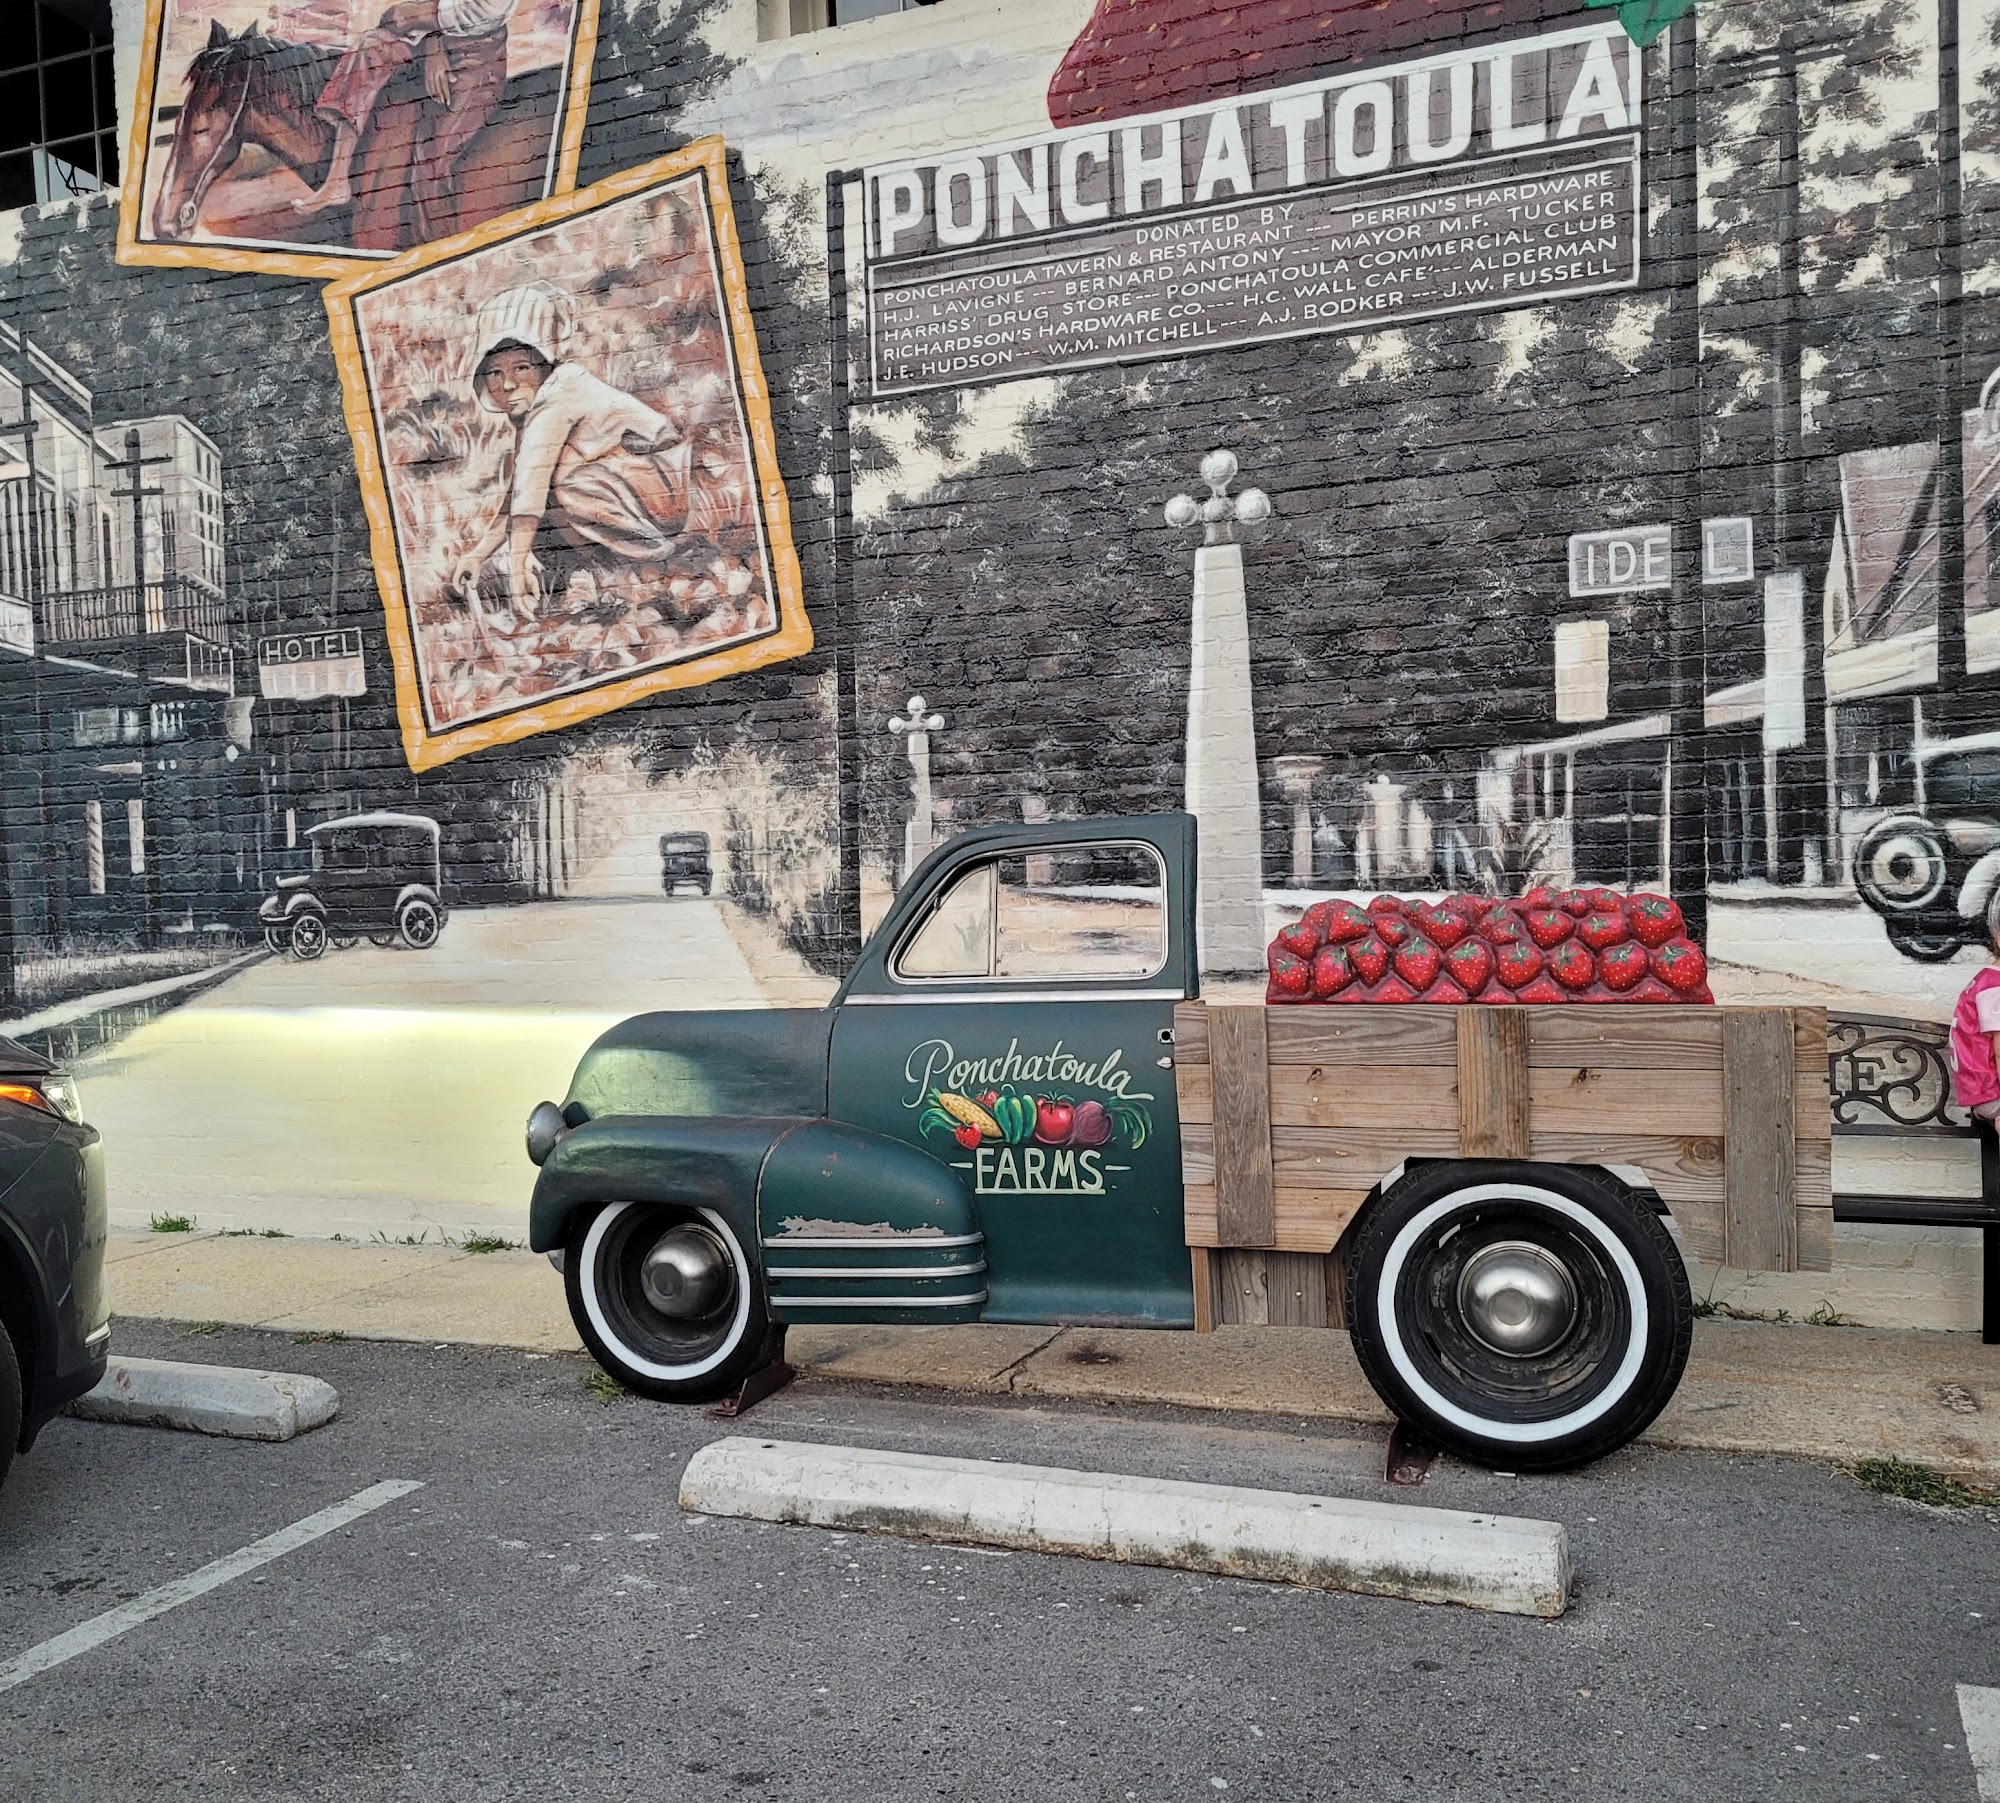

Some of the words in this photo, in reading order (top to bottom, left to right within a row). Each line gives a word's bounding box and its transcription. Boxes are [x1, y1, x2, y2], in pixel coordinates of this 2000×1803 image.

[880, 37, 1630, 256] PONCHATOULA
[884, 270, 1036, 305] PONCHATOULA
[1042, 254, 1121, 280] TAVERN
[1128, 253, 1143, 266] &
[1150, 225, 1294, 262] RESTAURANT
[1352, 197, 1456, 227] PERRIN'S
[1465, 170, 1613, 209] HARDWARE
[884, 309, 919, 324] H.J.
[933, 291, 1025, 317] LAVIGNE
[1065, 267, 1173, 288] BERNARD
[1182, 248, 1285, 277] ANTONY
[1331, 225, 1420, 251] MAYOR
[1440, 214, 1488, 234] M.F.
[1507, 192, 1615, 222] TUCKER
[884, 318, 976, 342] HARRISS'
[988, 307, 1048, 327] DRUG
[1062, 293, 1132, 315] STORE
[1167, 259, 1349, 299] PONCHATOULA
[1358, 229, 1534, 269] COMMERCIAL
[1545, 214, 1616, 239] CLUB
[1137, 214, 1239, 244] DONATED
[1261, 204, 1294, 225] BY
[883, 366, 914, 380] J.E.
[922, 350, 1012, 375] HUDSON
[1049, 339, 1099, 355] W.M.
[1107, 319, 1218, 347] MITCHELL
[1258, 311, 1296, 326] A.J.
[1304, 292, 1403, 319] BODKER
[1443, 277, 1493, 298] J.W.
[1503, 259, 1616, 289] FUSSELL
[884, 328, 1031, 361] RICHARDSON'S
[1039, 308, 1161, 338] HARDWARE
[1168, 303, 1205, 318] CO.
[1243, 291, 1285, 307] H.C.
[1294, 279, 1356, 299] WALL
[1469, 235, 1617, 272] ALDERMAN
[265, 633, 357, 664] HOTEL
[902, 1038, 1155, 1108] Ponchatoula
[976, 1148, 1104, 1191] FARMS
